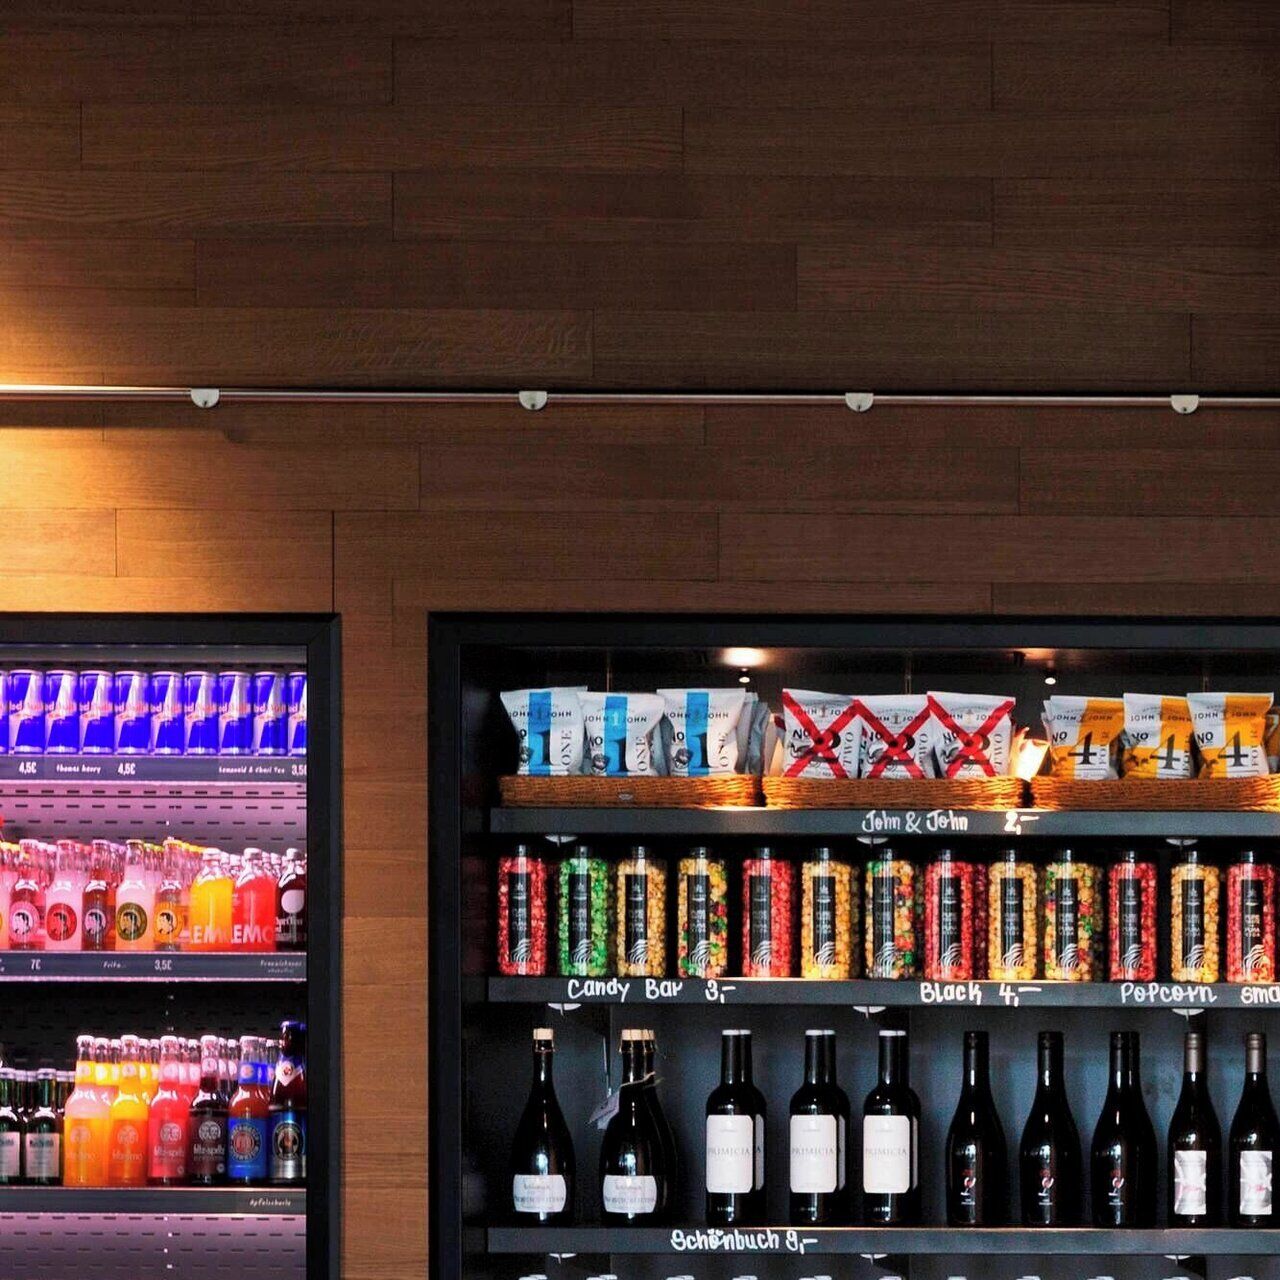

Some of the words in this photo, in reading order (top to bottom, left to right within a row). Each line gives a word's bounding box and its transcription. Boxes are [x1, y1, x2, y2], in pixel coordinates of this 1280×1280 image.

[862, 810, 900, 832] John
[905, 811, 922, 834] &
[926, 810, 969, 831] John
[567, 978, 631, 1003] Candy
[645, 979, 683, 1000] Bar
[920, 982, 982, 1006] Black
[671, 1229, 779, 1250] Schönbuch
